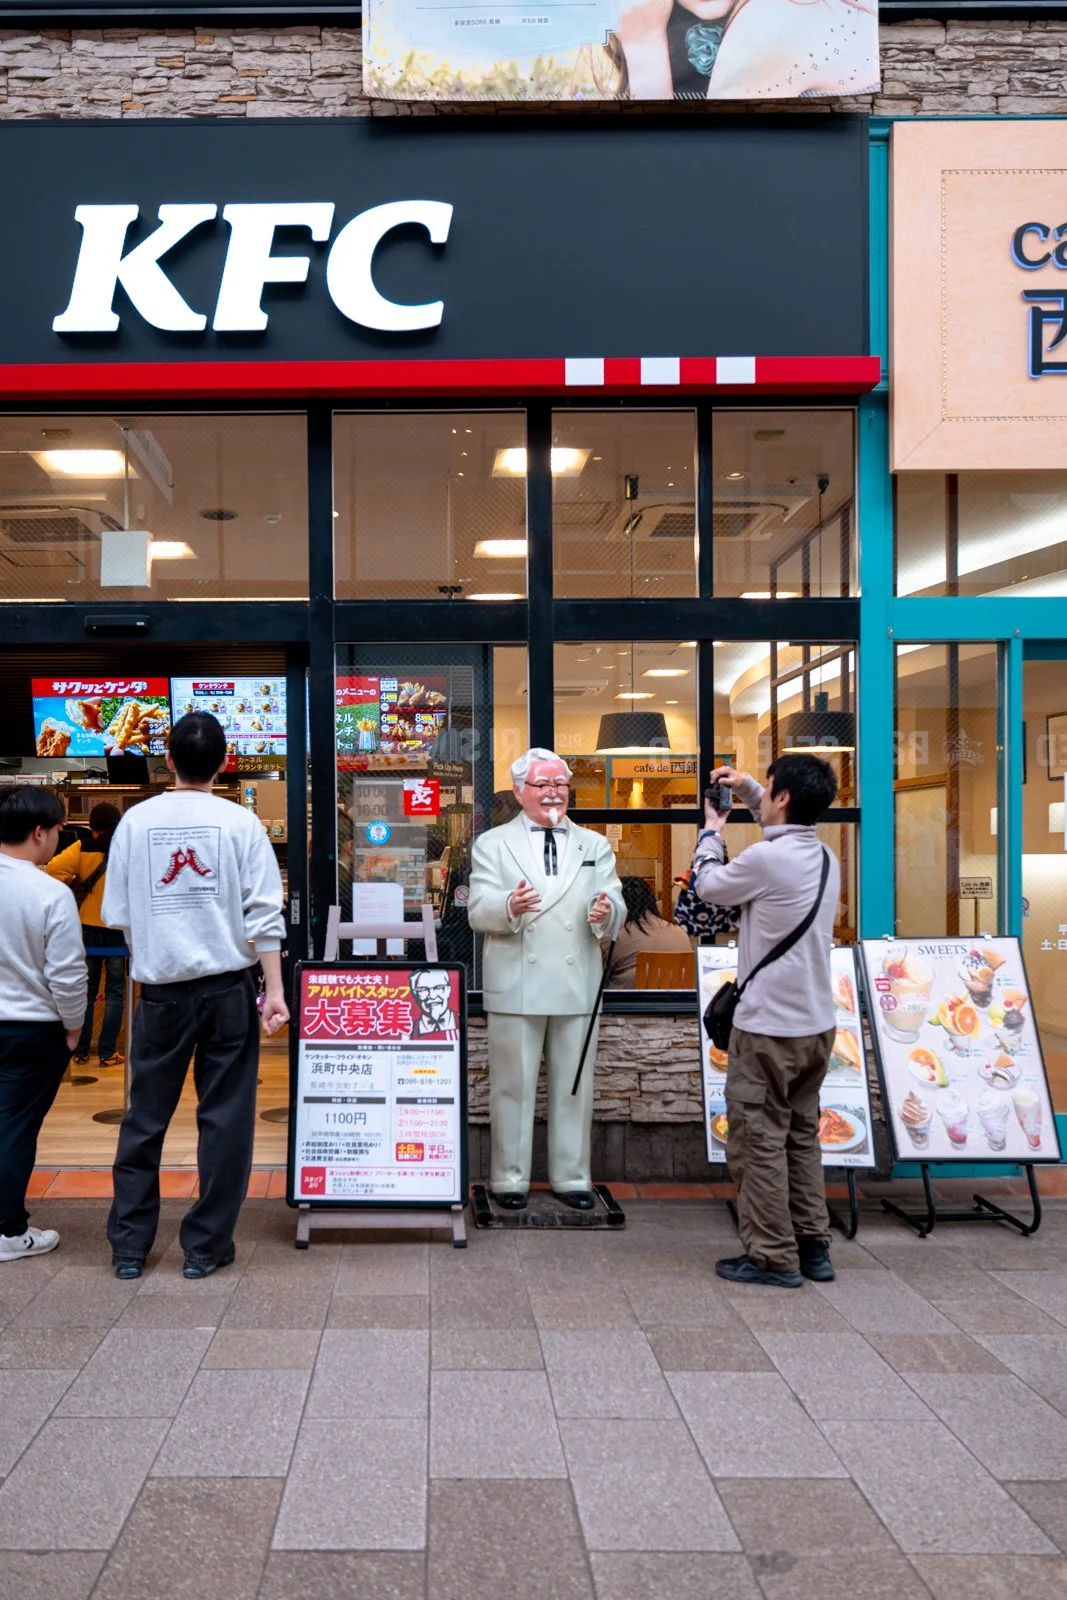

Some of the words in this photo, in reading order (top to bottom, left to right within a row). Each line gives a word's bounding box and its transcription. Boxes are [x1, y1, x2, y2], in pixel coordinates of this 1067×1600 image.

[52, 200, 454, 332] KFC
[634, 764, 655, 773] café
[656, 763, 669, 773] de
[918, 944, 968, 955] SWEETS
[307, 985, 410, 999] アルバイトスタッフ
[304, 999, 413, 1036] 大募集
[311, 1062, 373, 1075] 浜町中央店
[325, 1112, 367, 1126] 1100円
